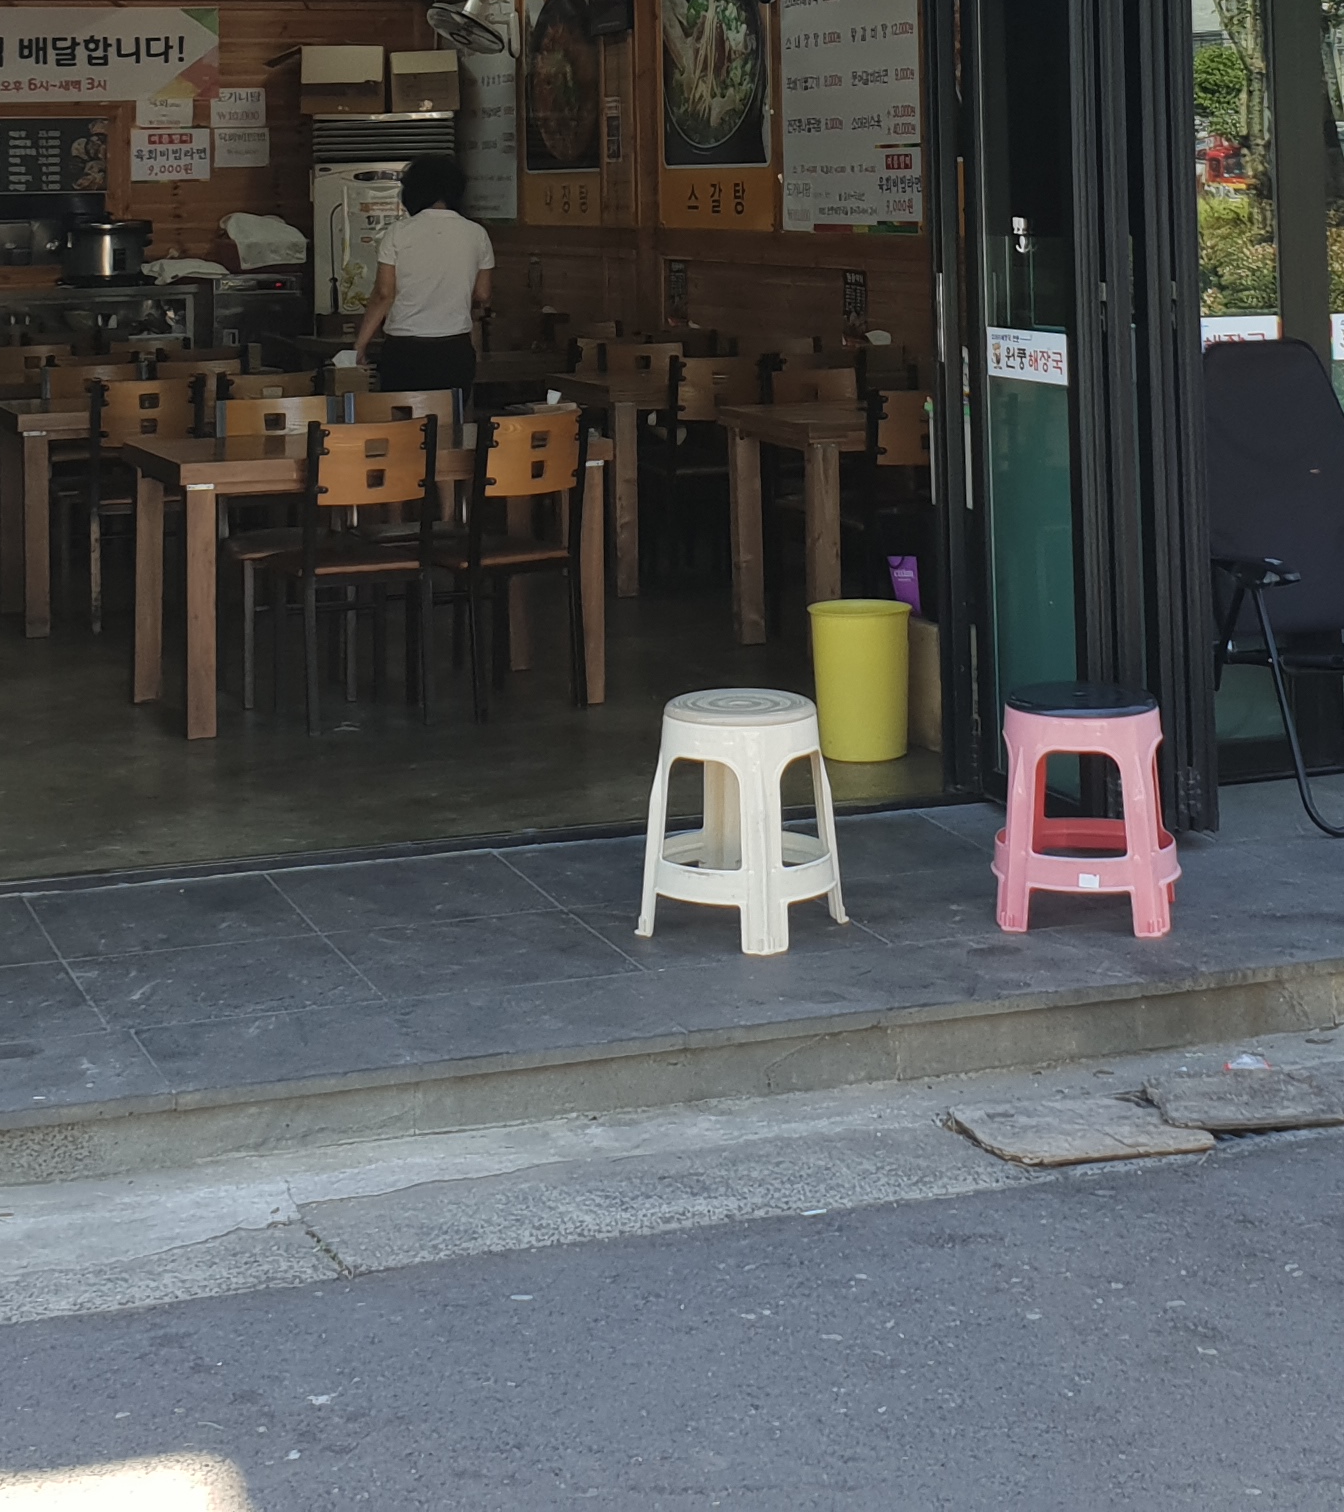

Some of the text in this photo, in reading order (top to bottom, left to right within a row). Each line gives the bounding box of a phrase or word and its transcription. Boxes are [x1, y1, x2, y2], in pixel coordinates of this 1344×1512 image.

[18, 34, 186, 68] 배달합니다!
[0, 80, 23, 93] 오후
[86, 77, 107, 91] 3시
[134, 147, 207, 161] 육회비빔라면
[148, 163, 193, 176] 9,000원
[1004, 346, 1063, 375] 원풍해장국
